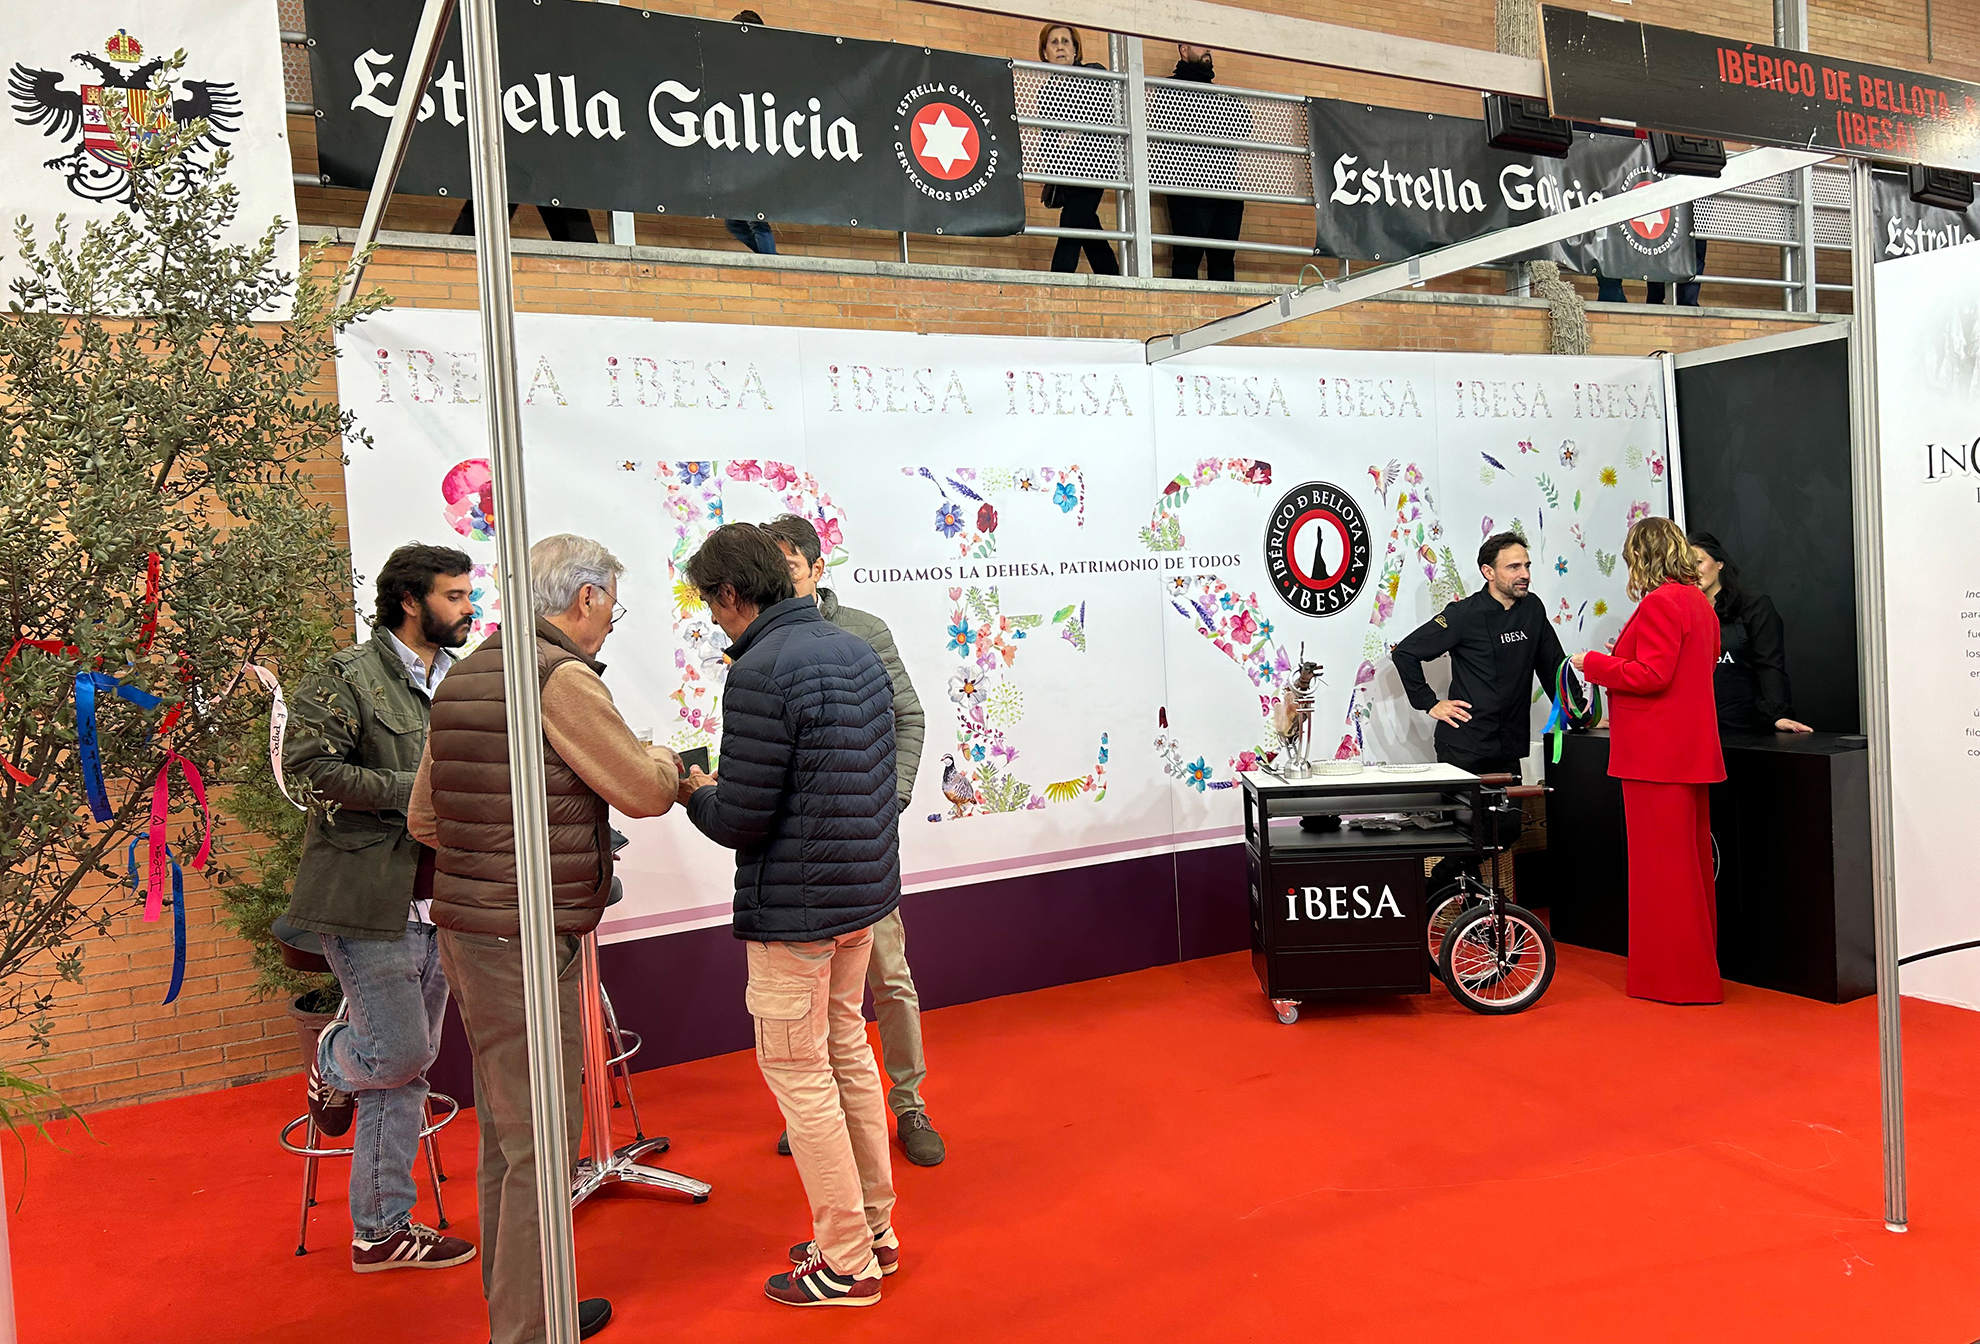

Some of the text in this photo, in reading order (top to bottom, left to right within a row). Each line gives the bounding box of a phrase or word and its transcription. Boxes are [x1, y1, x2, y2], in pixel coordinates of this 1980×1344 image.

[1716, 44, 1816, 98] IBÉRICO
[1821, 67, 1853, 104] DE
[648, 80, 863, 163] Galicia
[896, 82, 991, 127] ESTRELLA GALICIA
[894, 142, 999, 201] CERVECEROS DESDE 1906
[1330, 153, 1487, 213] Estrella
[1621, 165, 1650, 192] ESTRELLA
[1619, 222, 1652, 256] RVECEROS
[1653, 237, 1673, 256] DESDE
[1268, 504, 1296, 579] IBÉRICO
[1311, 490, 1363, 541] BELLOTA
[959, 566, 980, 579] LA
[1060, 558, 1159, 575] PATRIMONIO
[1165, 557, 1185, 569] DE
[1189, 554, 1241, 568] TODOS
